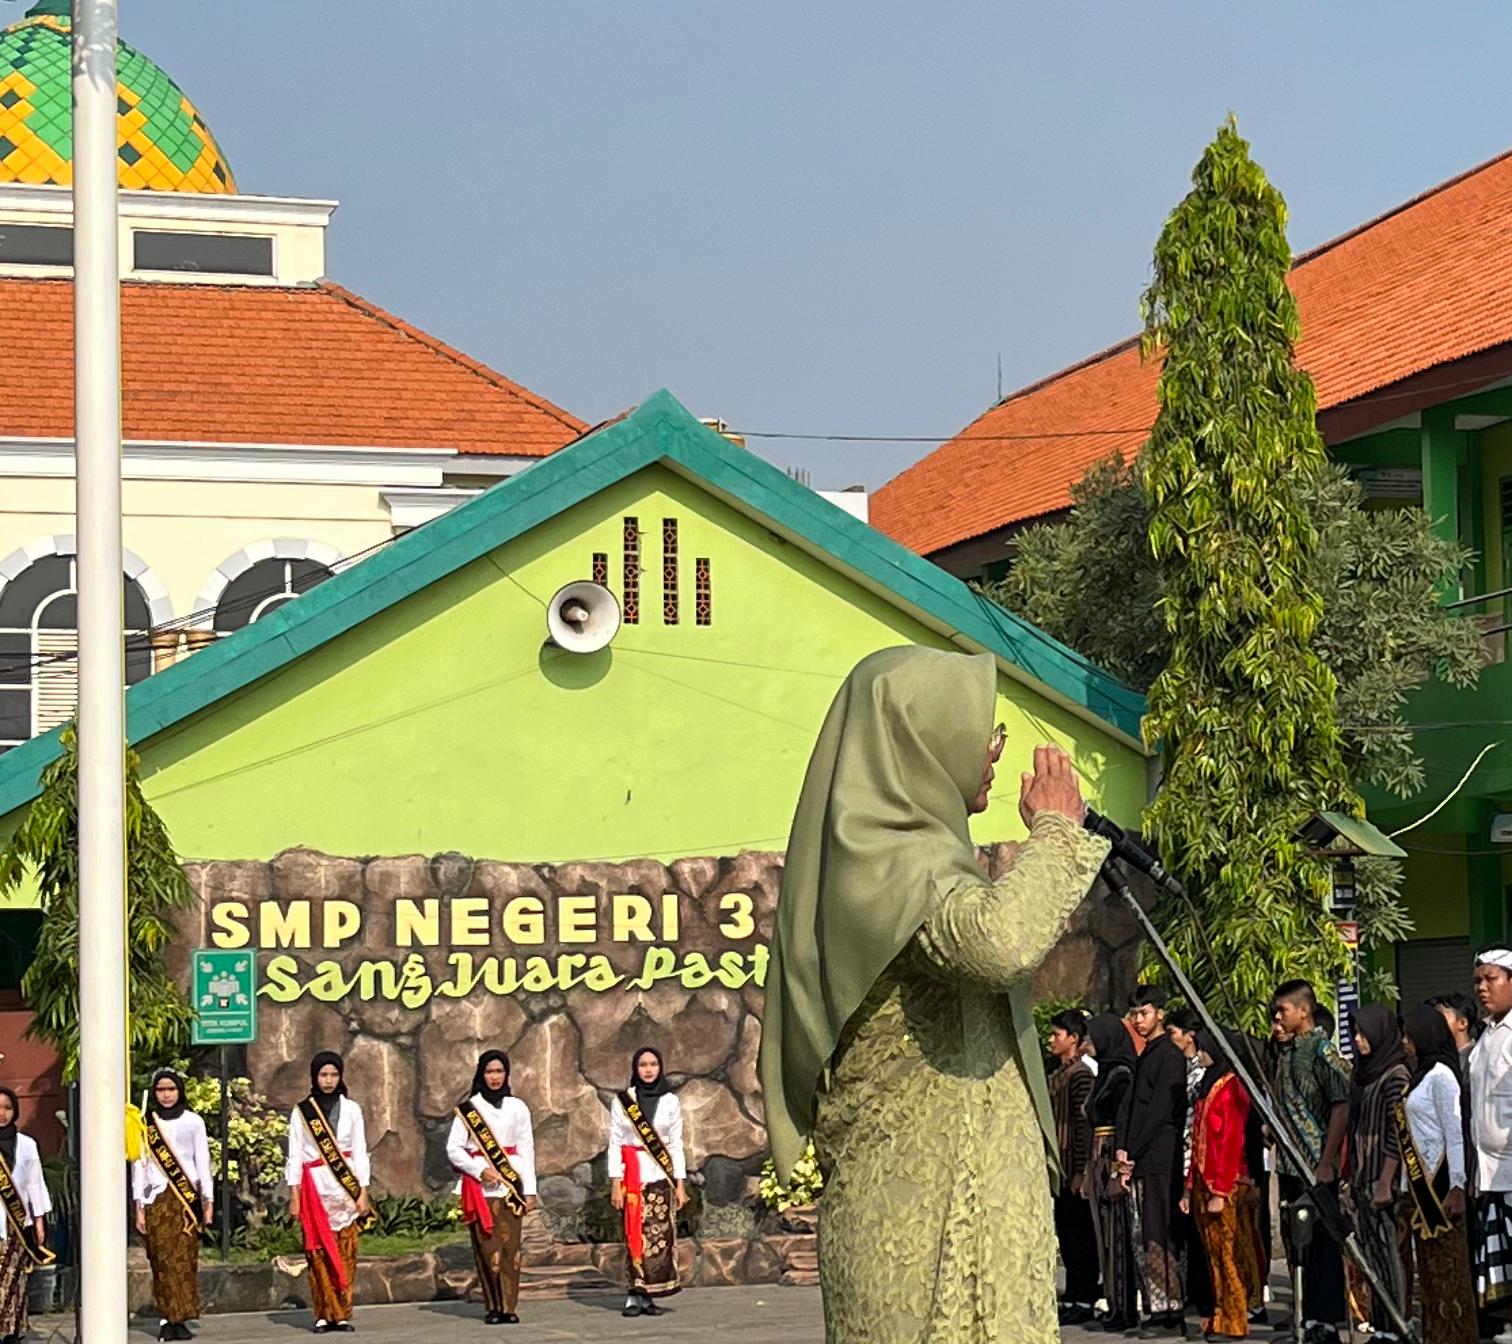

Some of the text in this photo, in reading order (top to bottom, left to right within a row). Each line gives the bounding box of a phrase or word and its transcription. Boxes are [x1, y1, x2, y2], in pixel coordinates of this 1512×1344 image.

[211, 892, 755, 949] SMP NEGERI 3
[256, 954, 433, 1009] Sang
[433, 951, 626, 997] Juara
